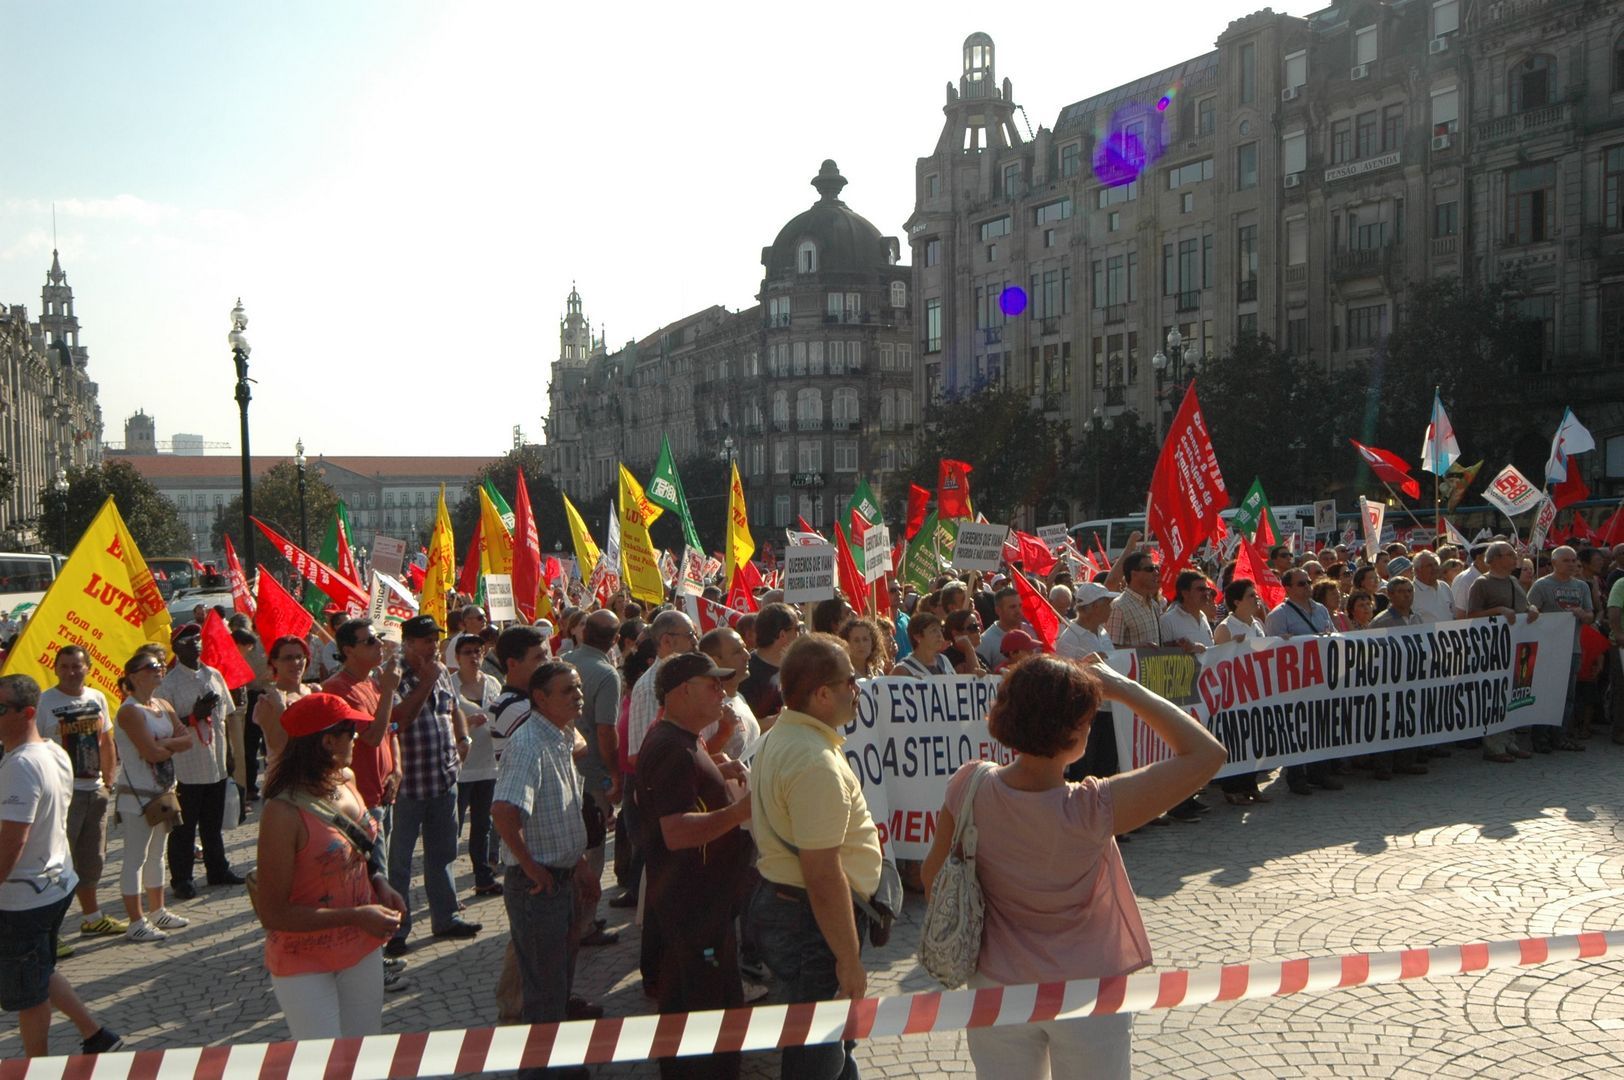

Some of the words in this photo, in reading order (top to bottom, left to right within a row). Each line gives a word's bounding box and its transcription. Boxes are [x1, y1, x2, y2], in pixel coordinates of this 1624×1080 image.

[1363, 155, 1398, 171] AVENIDA
[66, 610, 91, 631] Com
[91, 627, 104, 641] os
[1199, 640, 1324, 716] CONTRA
[1327, 640, 1339, 690] O
[1344, 635, 1402, 688] PACTO
[1401, 633, 1427, 682] DE
[1427, 616, 1511, 679] AGRESSÃO
[1216, 693, 1377, 764] EMPOBRECIMENTO
[1381, 692, 1390, 740] E
[1394, 688, 1416, 738] AS
[1420, 676, 1509, 735] INJUSTIÇAS
